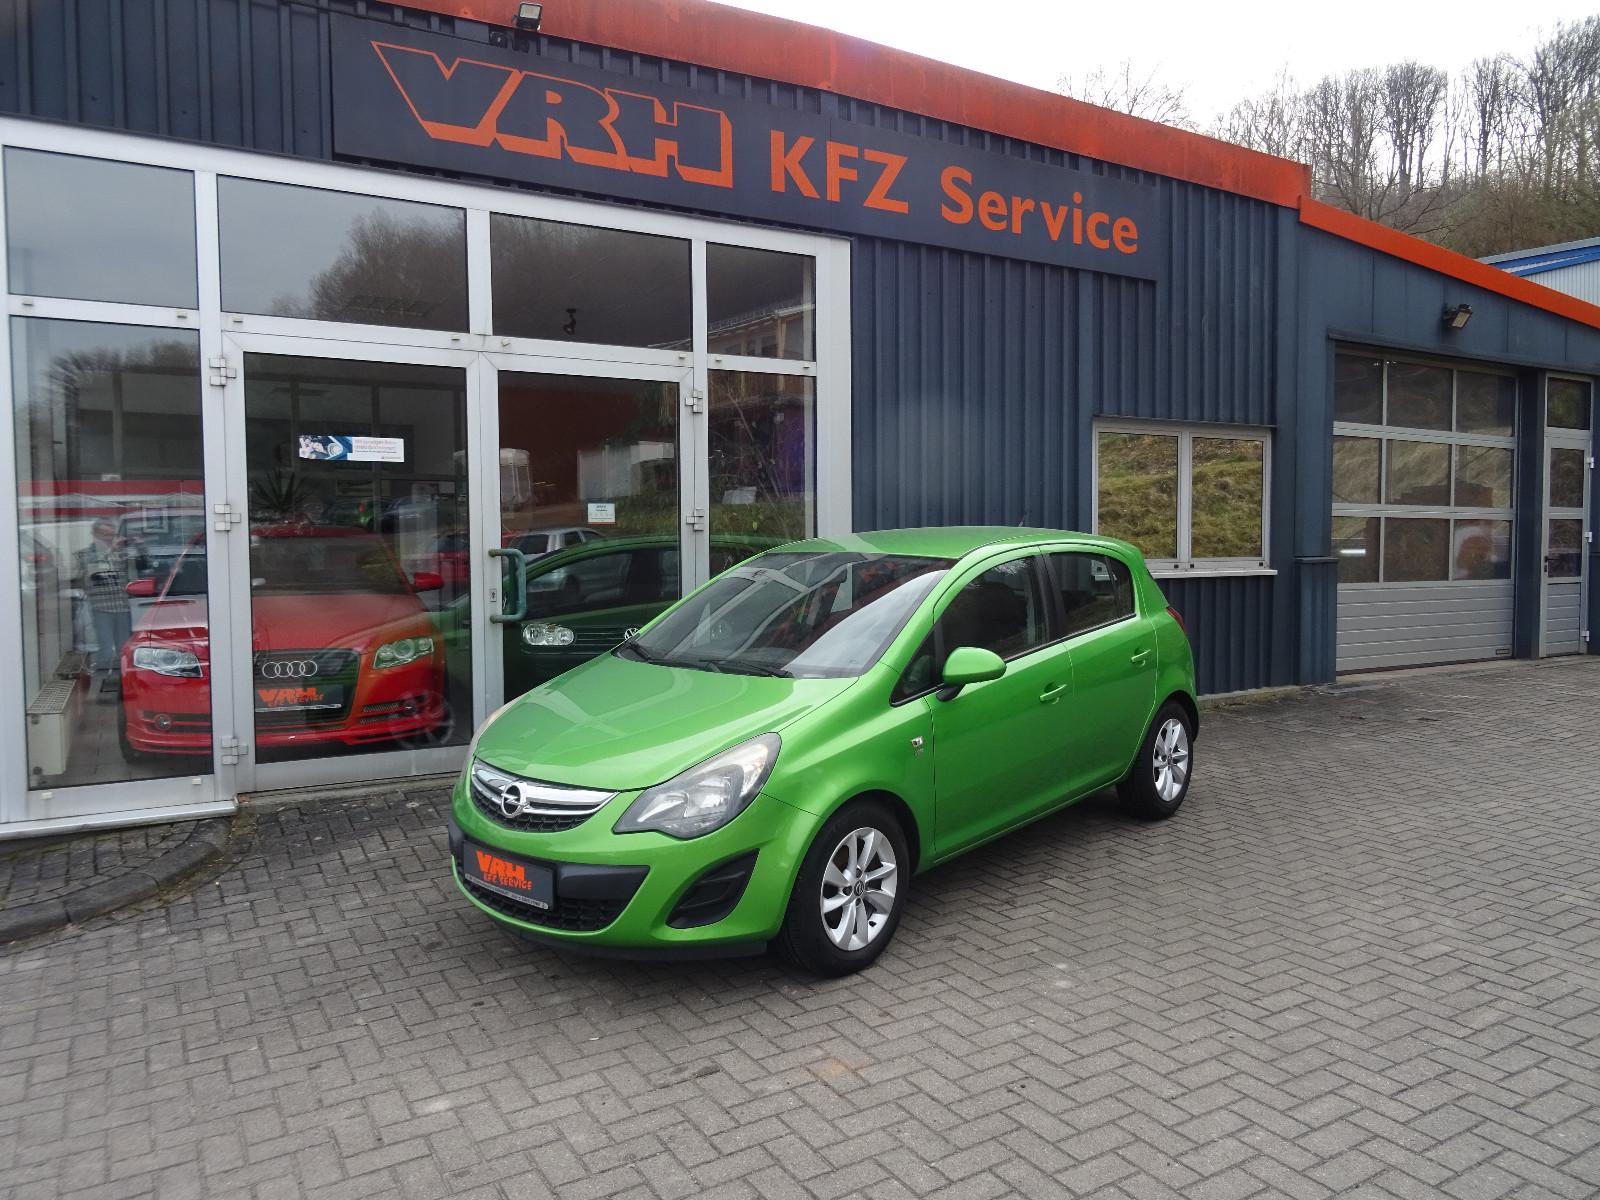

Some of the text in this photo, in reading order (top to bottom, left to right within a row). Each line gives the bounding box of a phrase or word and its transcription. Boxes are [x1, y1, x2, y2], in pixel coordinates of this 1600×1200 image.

[371, 41, 1138, 255] VRH KFZ Service
[476, 850, 525, 881] VRH
